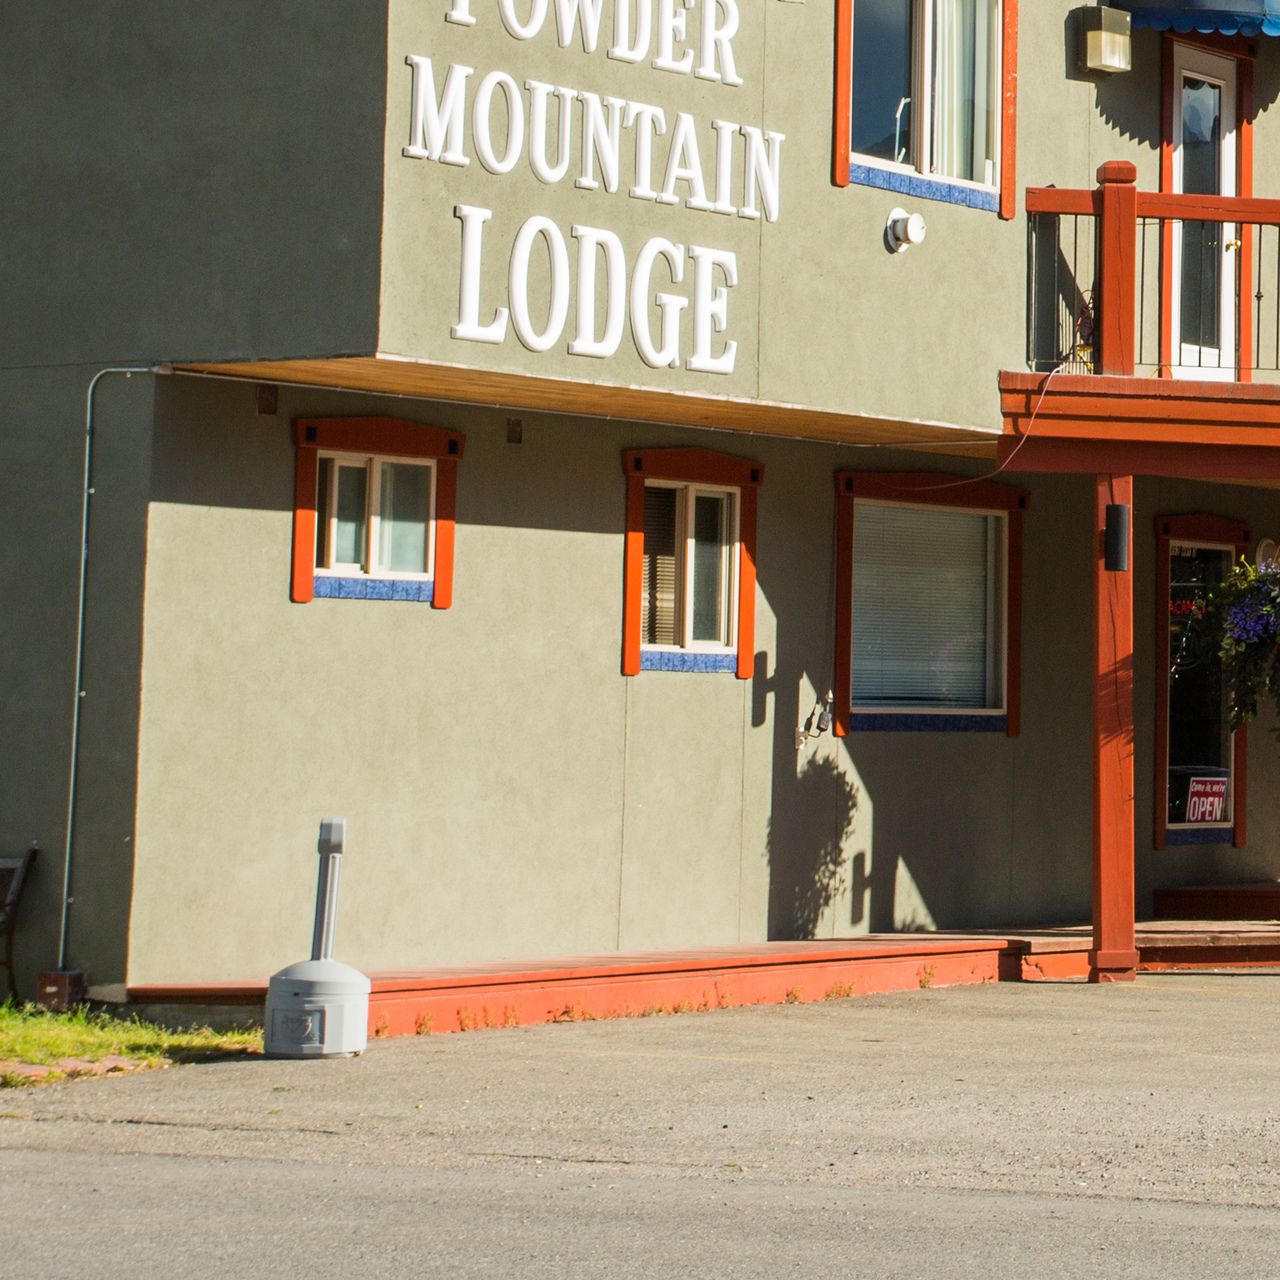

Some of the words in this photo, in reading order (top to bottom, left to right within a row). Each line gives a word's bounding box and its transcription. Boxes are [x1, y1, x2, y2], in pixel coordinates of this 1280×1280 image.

[402, 54, 786, 222] MOUNTAIN
[450, 204, 738, 374] LODGE
[1189, 796, 1223, 821] OPEN
